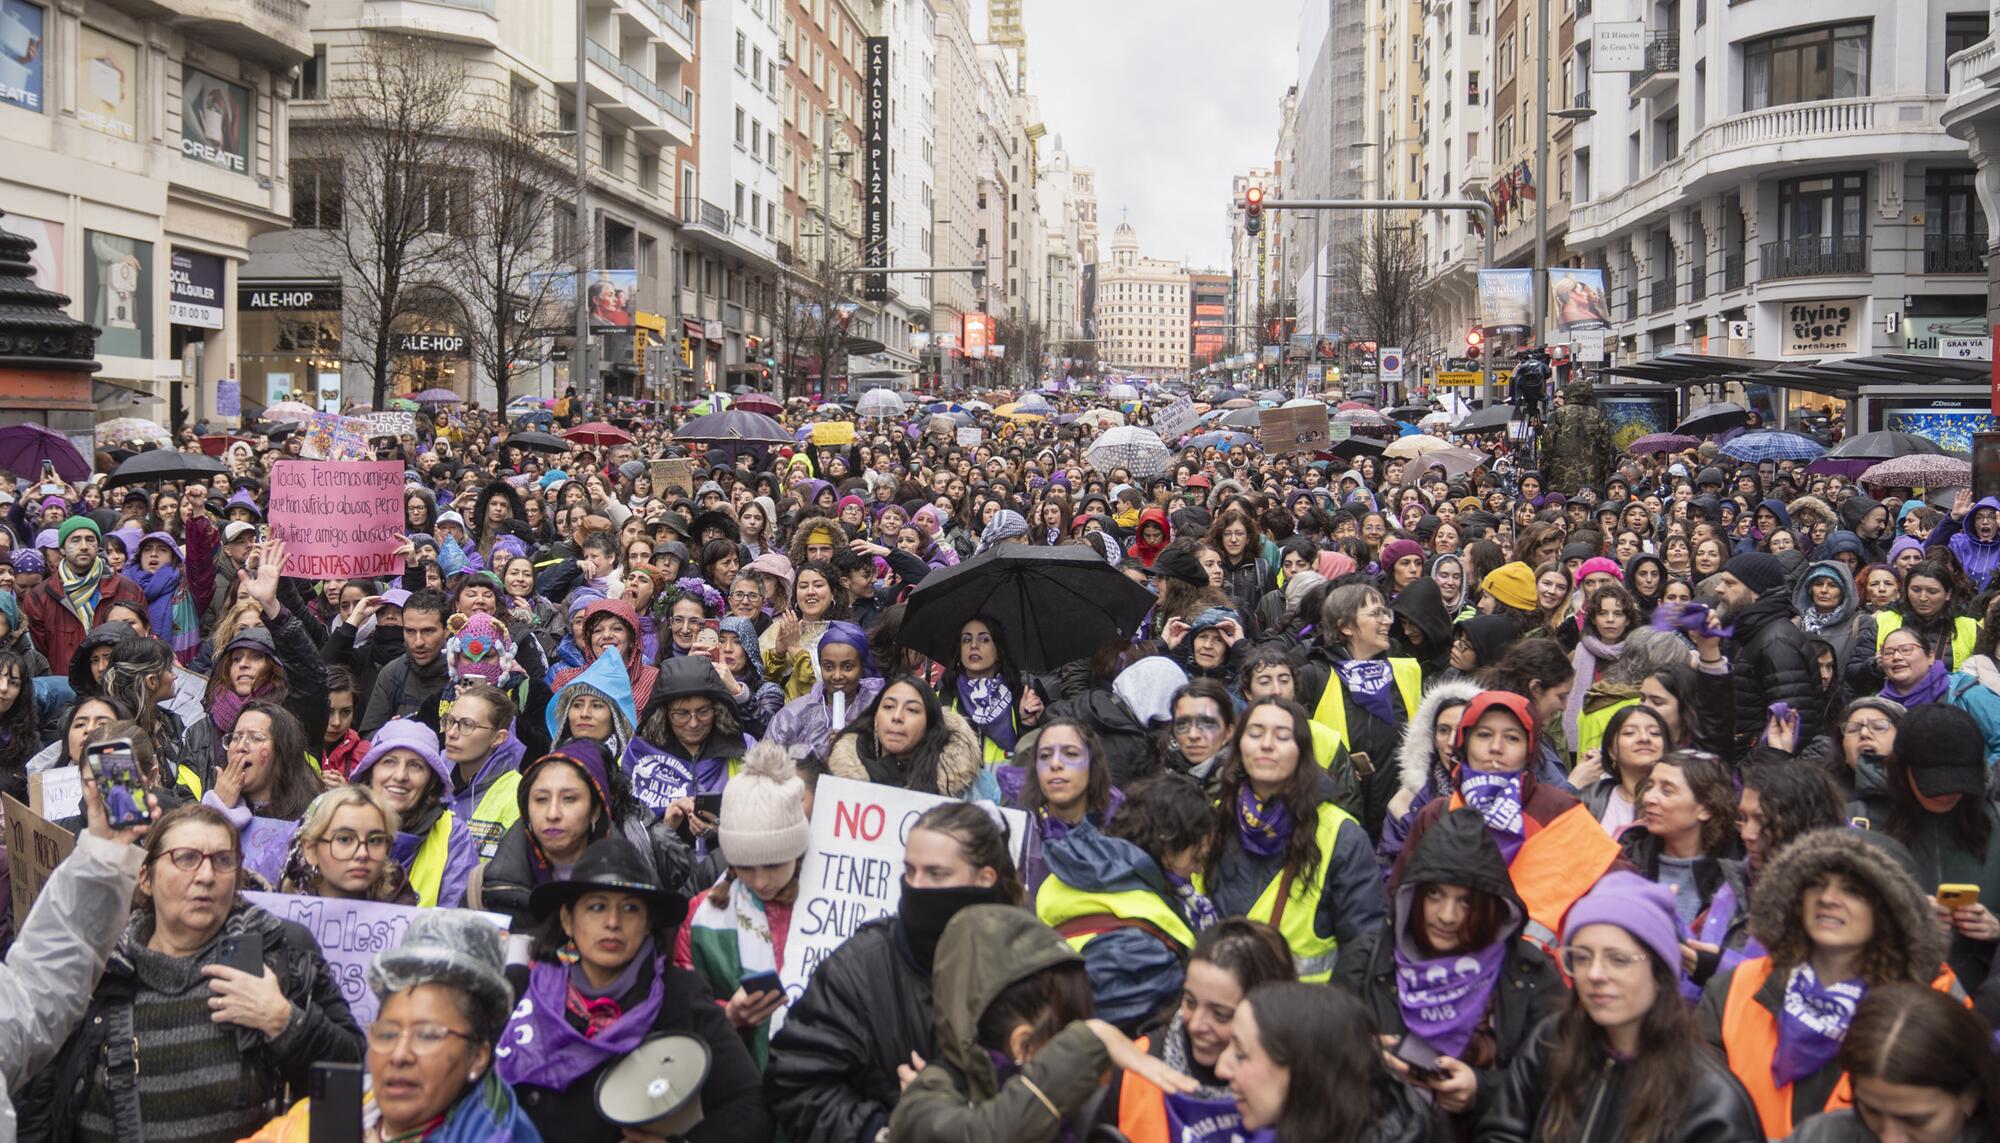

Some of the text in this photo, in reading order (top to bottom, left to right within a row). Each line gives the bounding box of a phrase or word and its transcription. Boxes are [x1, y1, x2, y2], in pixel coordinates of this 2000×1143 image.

[872, 44, 882, 142] CATALONIA
[77, 108, 134, 137] CREATE
[180, 138, 245, 171] CREATE
[872, 150, 882, 205] PLAZA
[170, 269, 191, 285] OCAL
[177, 284, 215, 300] ALQUILER
[251, 292, 313, 307] ALE-HOP
[179, 305, 187, 317] 81
[188, 307, 199, 319] 00
[201, 309, 210, 321] 10
[1790, 306, 1850, 324] flying
[1793, 323, 1847, 341] tiger
[401, 336, 464, 351] ALE-HOP
[1793, 342, 1847, 351] copenhagen
[1907, 337, 1937, 350] Hall
[1959, 349, 1971, 357] 69
[371, 423, 411, 434] PODER
[275, 464, 401, 490] Todas tenemos amigas
[285, 494, 301, 513] han
[302, 494, 334, 514] sufrido
[375, 497, 399, 516] pero
[289, 522, 312, 544] tiene
[315, 526, 347, 548] amigos
[352, 523, 403, 544] abusadores
[297, 554, 351, 575] CUENTAS
[353, 555, 371, 574] NO
[372, 553, 397, 573] DAN
[834, 800, 886, 842] NO
[819, 851, 892, 900] TENER
[288, 900, 410, 952] Molest
